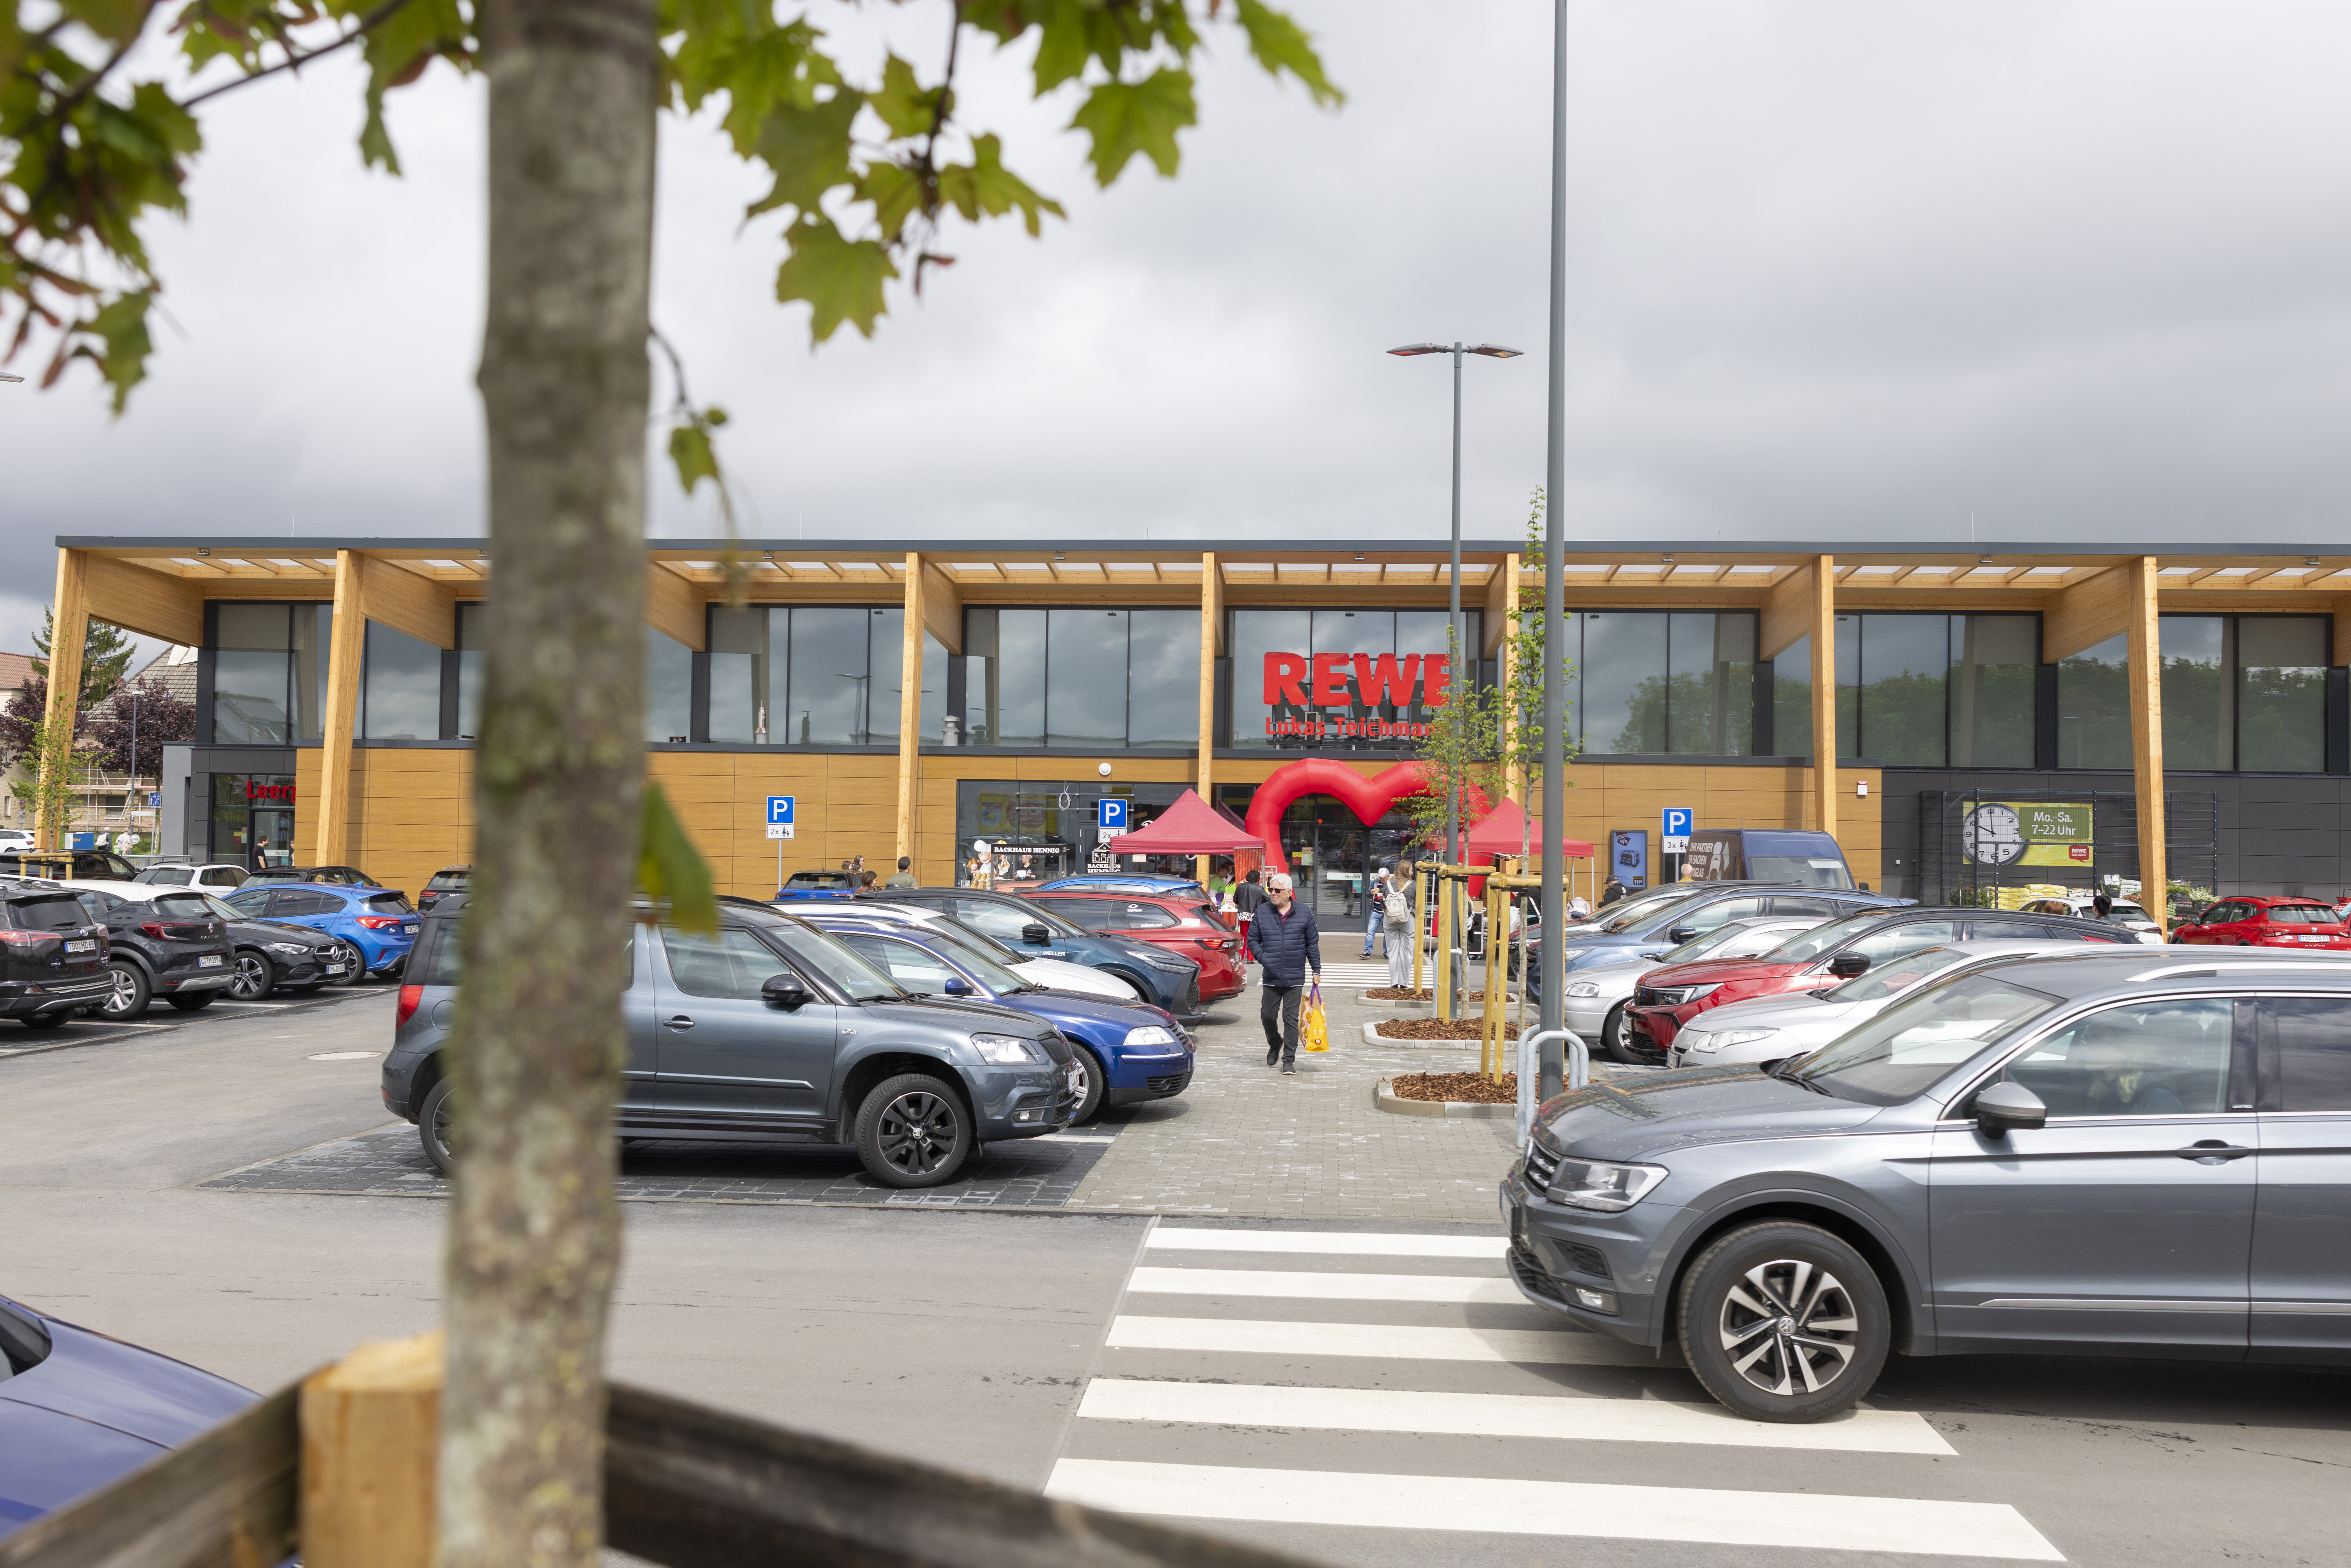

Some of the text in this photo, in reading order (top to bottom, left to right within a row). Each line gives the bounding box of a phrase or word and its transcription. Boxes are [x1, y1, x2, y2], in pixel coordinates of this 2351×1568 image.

[1263, 652, 1461, 707] REWE
[1266, 716, 1446, 737] Lukas Teichman
[773, 800, 788, 820] P
[1105, 803, 1121, 824] P
[1670, 812, 1686, 833] P
[2058, 825, 2076, 835] Uhr
[1696, 843, 1713, 853] PARTNER
[1688, 855, 1707, 865] IN SACHEN
[1692, 867, 1704, 878] OGLAS
[81, 941, 88, 949] HD
